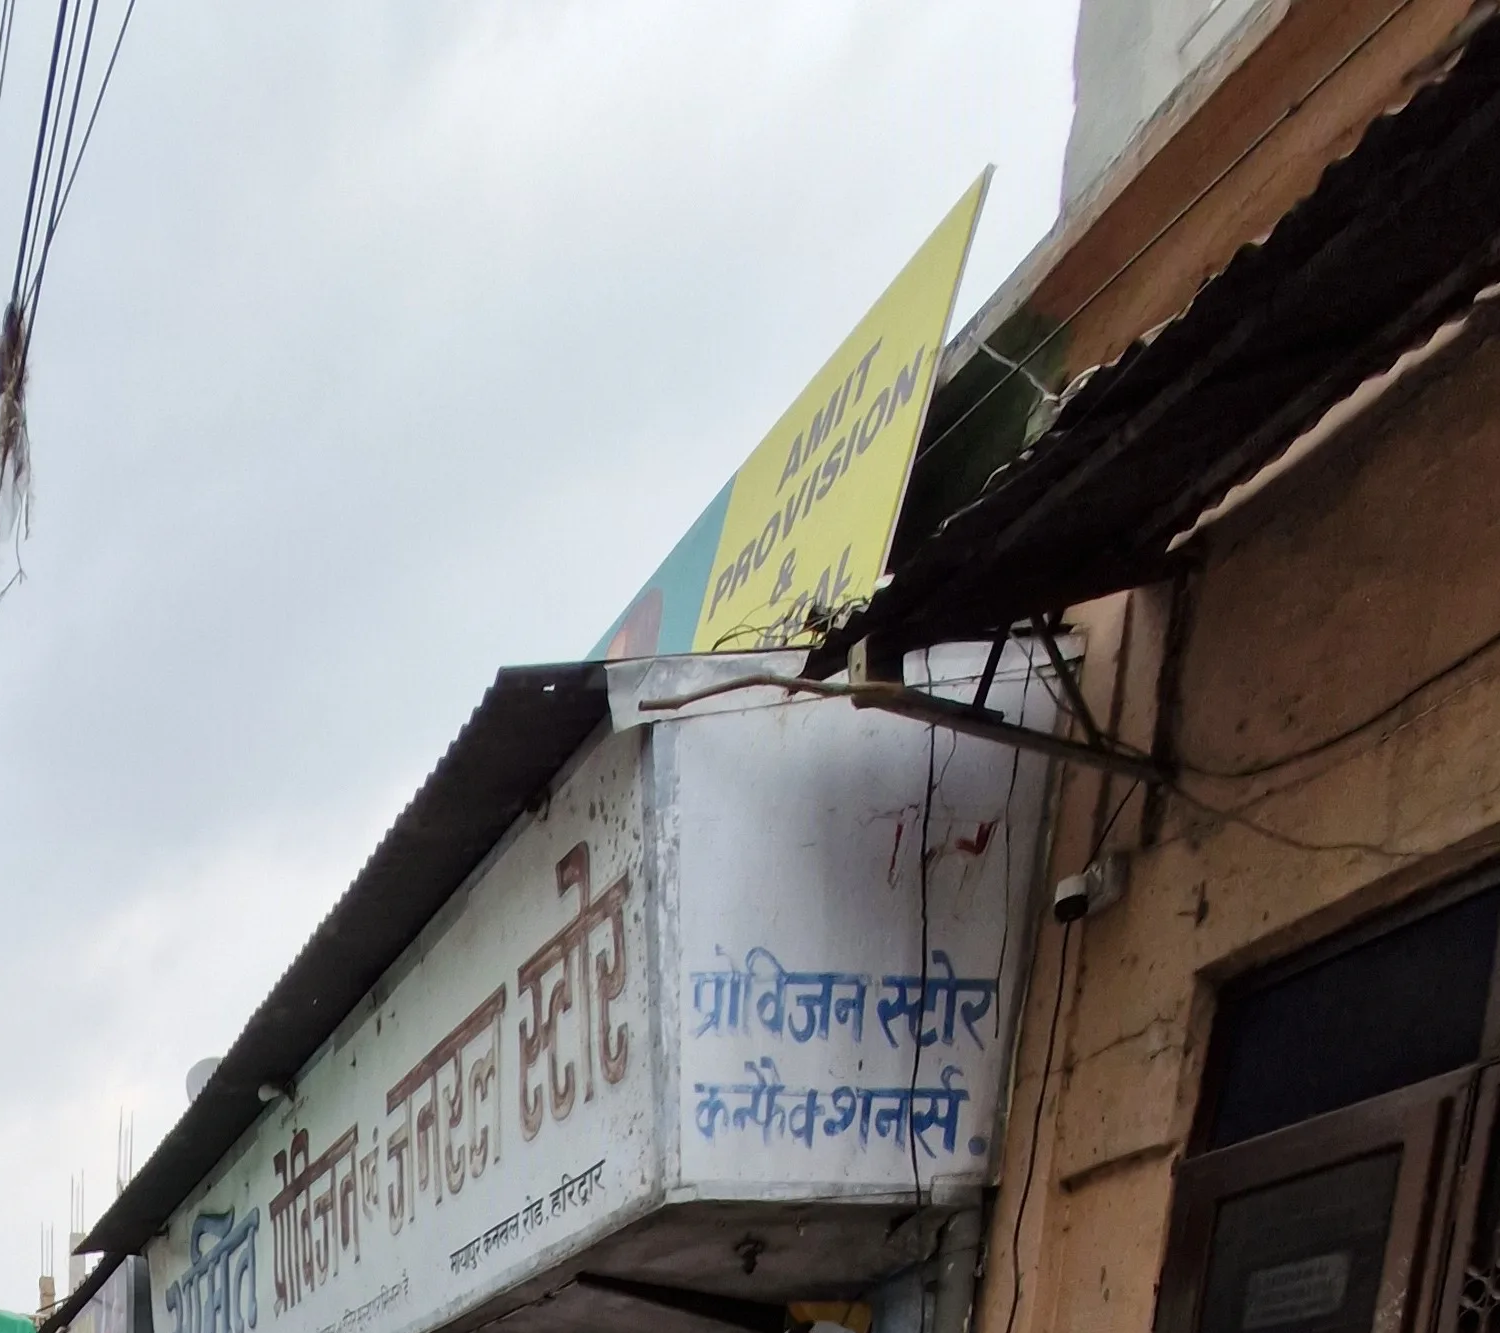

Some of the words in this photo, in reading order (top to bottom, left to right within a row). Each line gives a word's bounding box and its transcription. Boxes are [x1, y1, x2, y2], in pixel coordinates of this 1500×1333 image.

[775, 336, 883, 497] AMIT
[707, 343, 926, 624] PROVISION
[768, 547, 797, 607] &
[690, 944, 869, 1045] प्रोविजन
[877, 949, 998, 1050] स्टोर
[269, 1122, 360, 1319] प्रोविजन
[386, 982, 507, 1236] जनरल
[518, 840, 632, 1143] स्टोर
[549, 1159, 607, 1217] हरिद्वार
